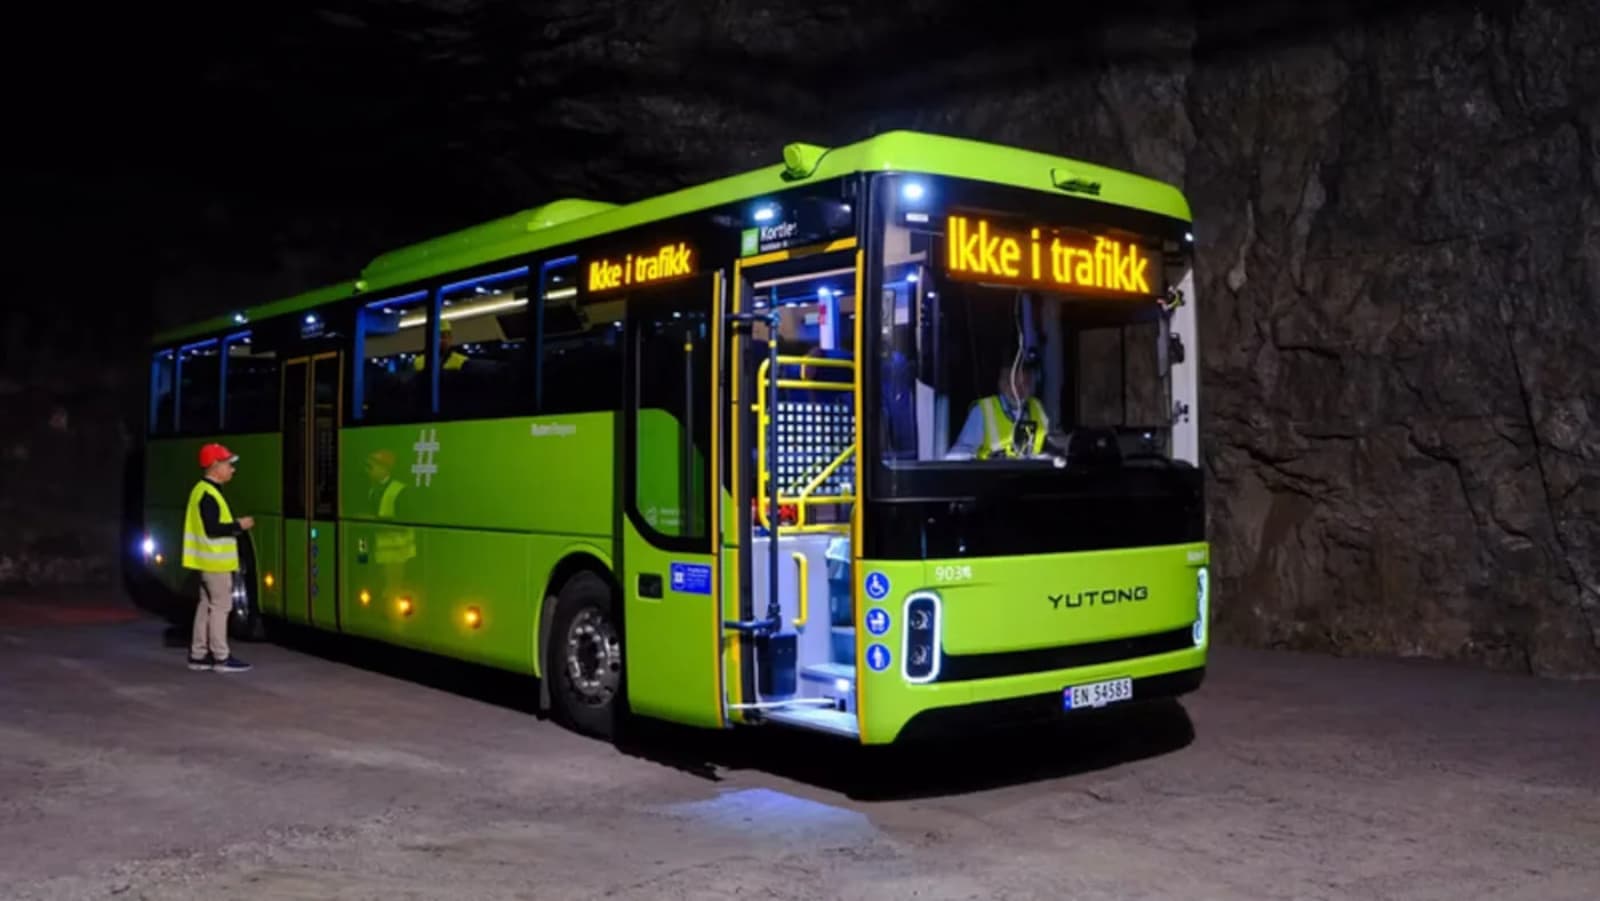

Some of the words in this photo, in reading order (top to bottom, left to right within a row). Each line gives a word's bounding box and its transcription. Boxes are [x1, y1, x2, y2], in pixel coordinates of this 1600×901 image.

[589, 260, 622, 291] Ikke
[625, 253, 632, 285] i
[635, 242, 691, 283] trafikk
[948, 216, 1020, 277] Ikke
[1031, 228, 1040, 279] i
[1051, 235, 1149, 293] trafikk
[1047, 586, 1148, 609] YUTONG
[1073, 688, 1089, 705] EN
[1094, 680, 1129, 701] 54585
